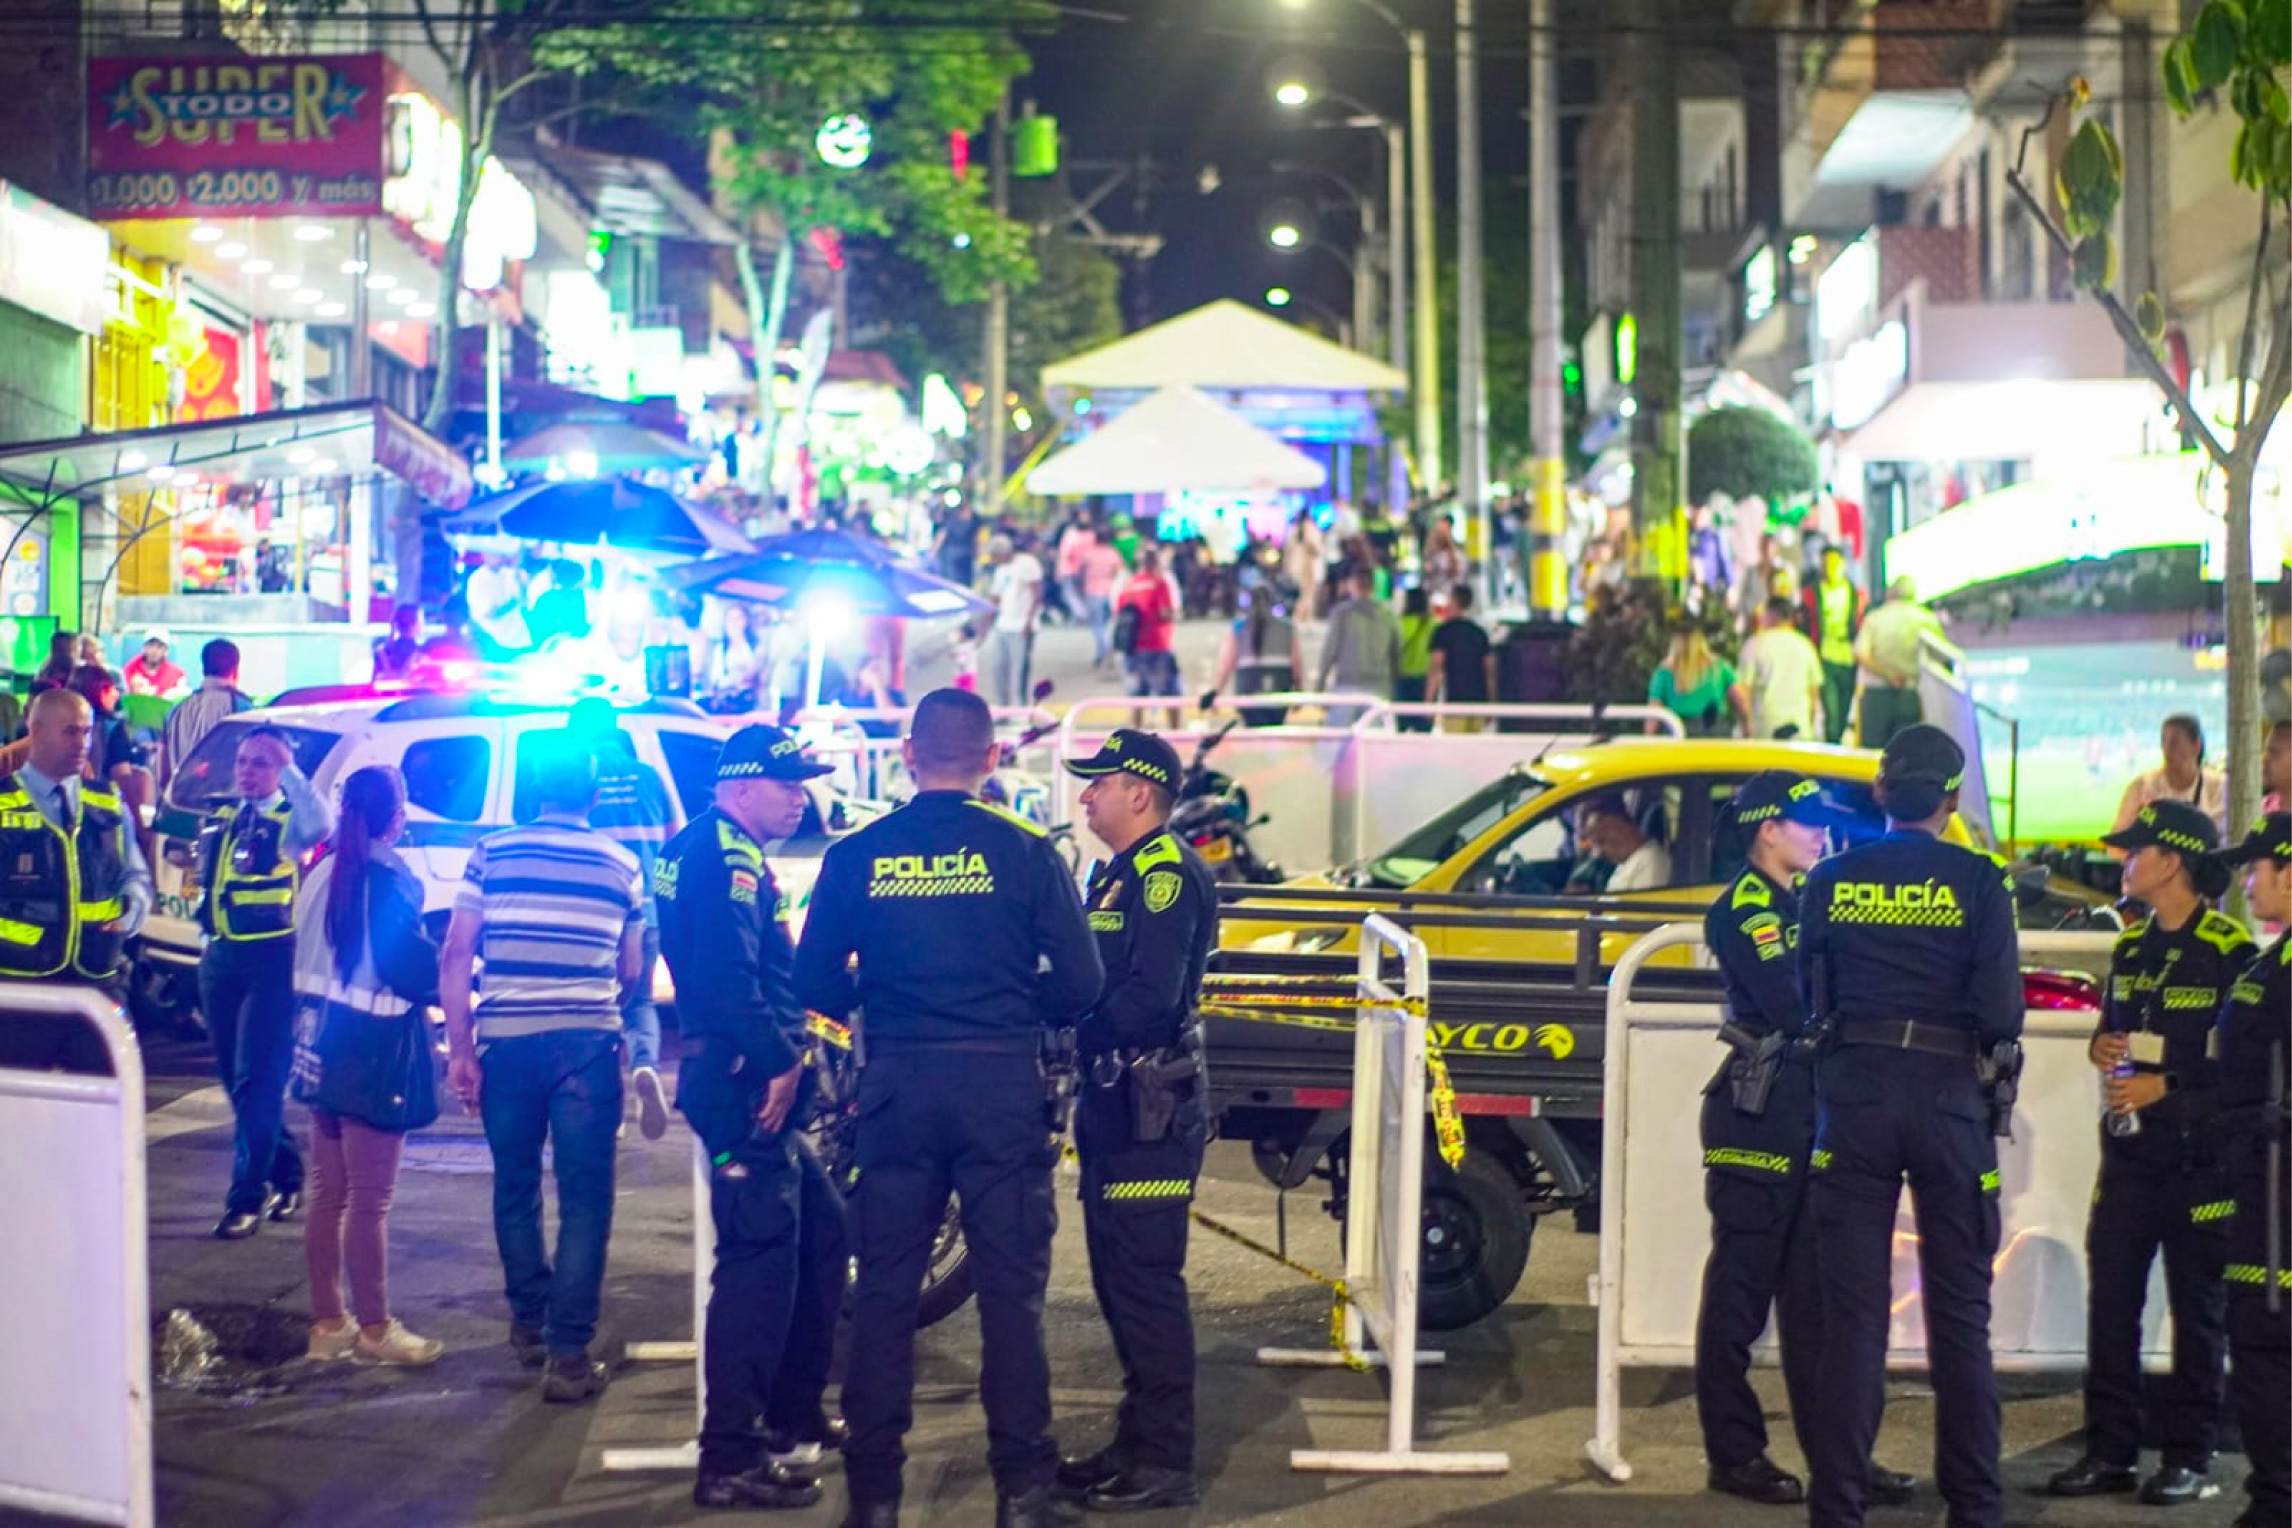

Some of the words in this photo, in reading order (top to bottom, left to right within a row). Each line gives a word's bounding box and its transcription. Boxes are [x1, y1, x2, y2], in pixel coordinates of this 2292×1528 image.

[131, 62, 334, 146] SUPER
[161, 93, 290, 116] TODO
[873, 845, 989, 880] POLICÍA
[1833, 876, 1957, 909] POLICÍA
